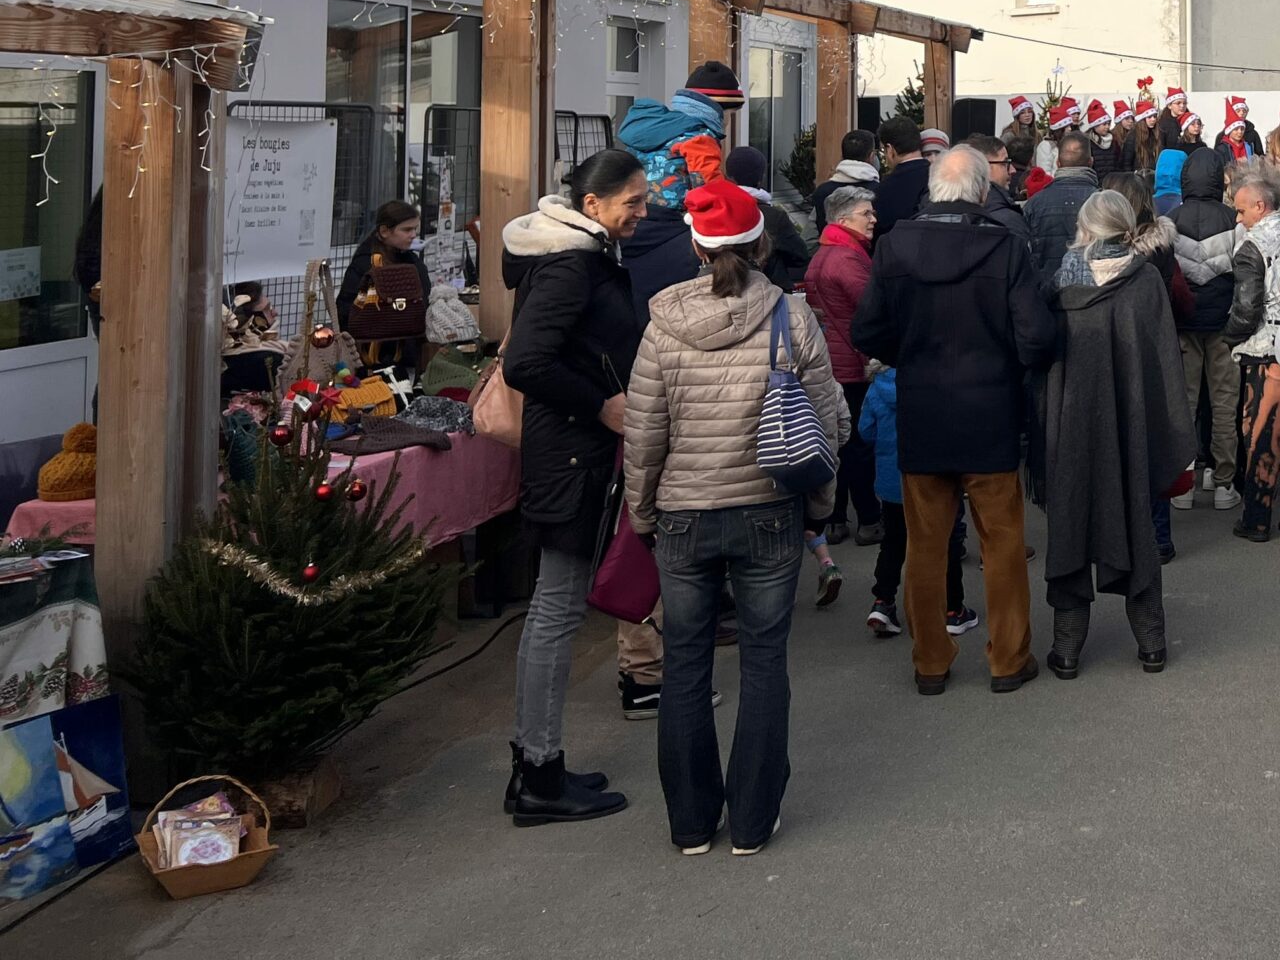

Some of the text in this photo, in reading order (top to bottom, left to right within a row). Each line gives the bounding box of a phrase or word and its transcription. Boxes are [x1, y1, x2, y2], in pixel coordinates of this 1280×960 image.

[242, 136, 290, 154] Les bougies
[250, 158, 281, 175] de Juju
